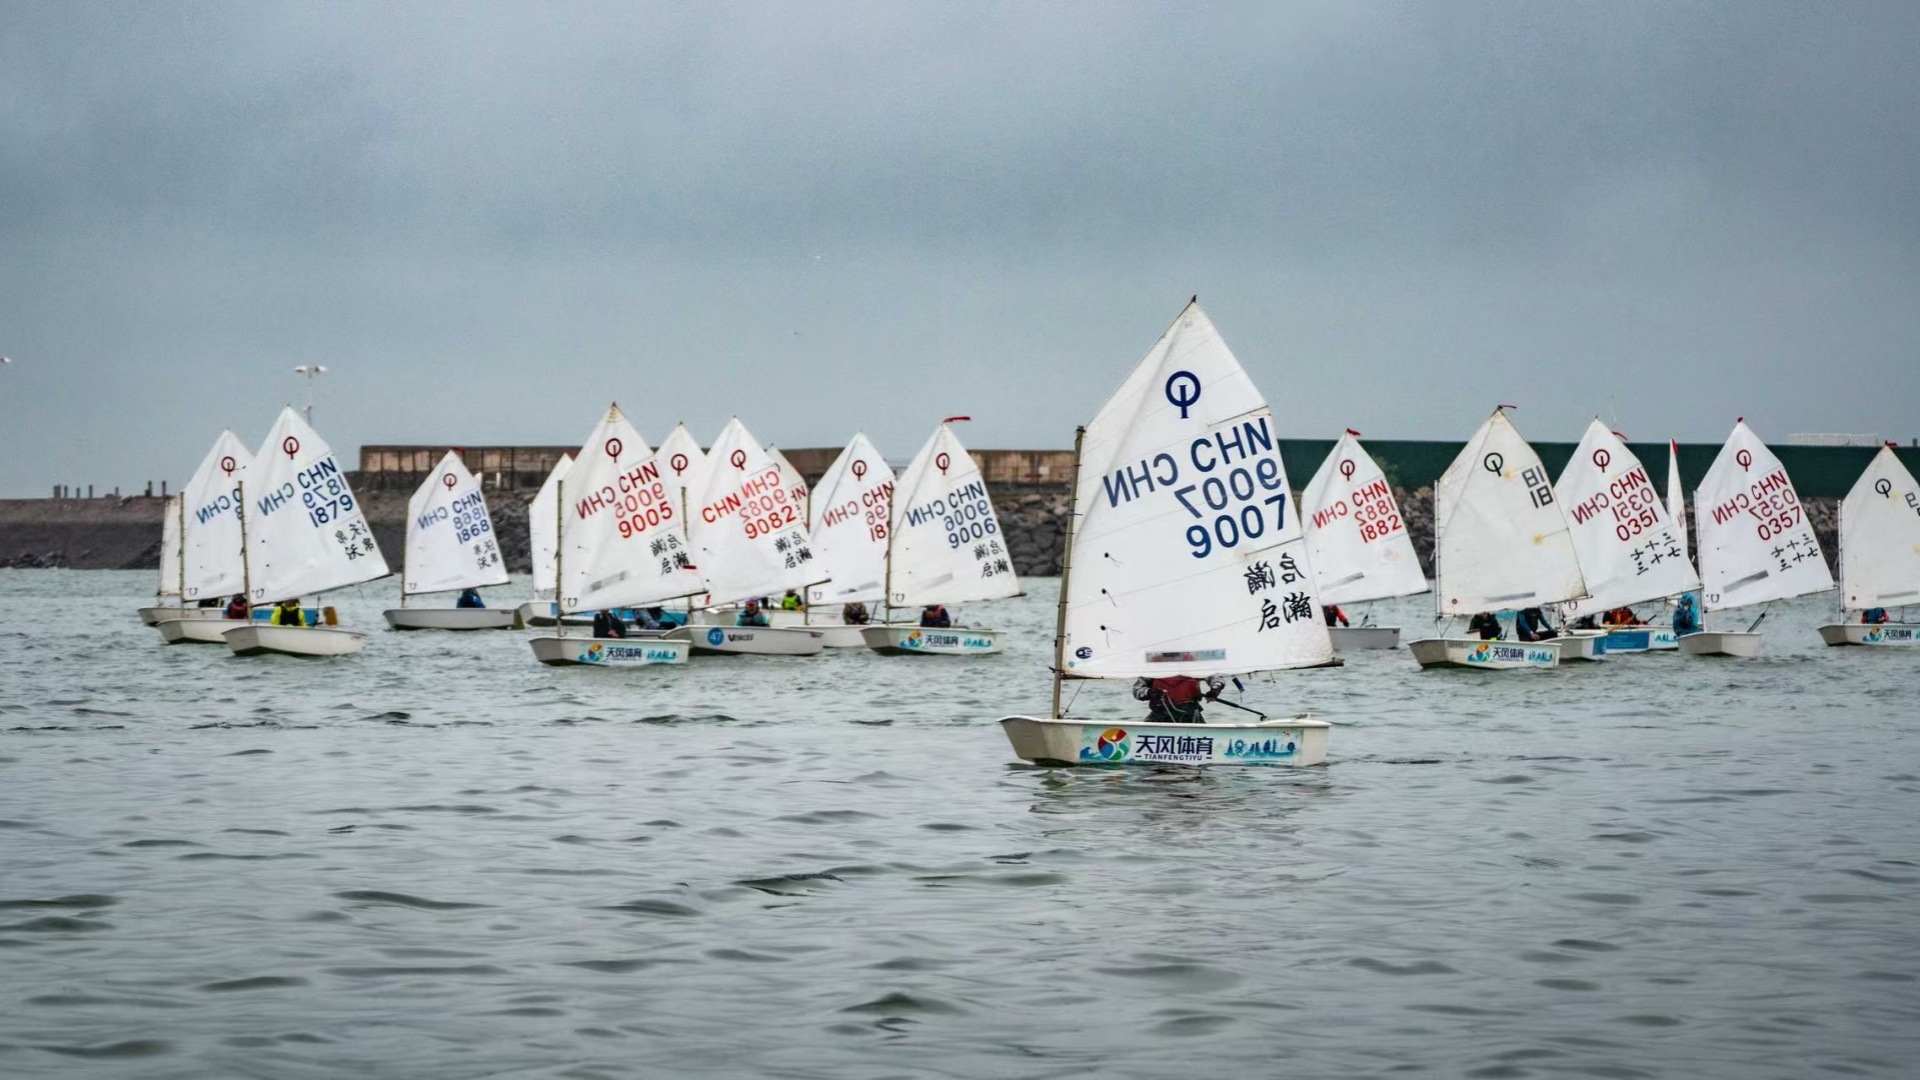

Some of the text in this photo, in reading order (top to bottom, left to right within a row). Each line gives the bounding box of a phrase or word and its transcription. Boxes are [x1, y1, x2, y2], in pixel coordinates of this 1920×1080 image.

[1191, 418, 1273, 473] CHN
[297, 457, 338, 489] CHN
[618, 461, 660, 493] CHN
[1610, 467, 1647, 500] CHN
[1751, 470, 1788, 500] CHN
[452, 490, 482, 514] CHN
[702, 493, 741, 523] CHN
[862, 481, 895, 507] CHN
[948, 480, 985, 509] CHN
[1352, 479, 1388, 507] CHN
[309, 494, 353, 528] 1879
[618, 501, 673, 539] 9005
[744, 505, 797, 539] 9082
[1186, 493, 1286, 559] 9007
[1616, 507, 1659, 542] 0351
[1757, 505, 1800, 541] 0357
[456, 519, 490, 545] 1868
[870, 521, 890, 542] 18
[948, 518, 996, 549] 9006
[1360, 514, 1402, 543] 1882
[1135, 734, 1214, 755] 天风体育
